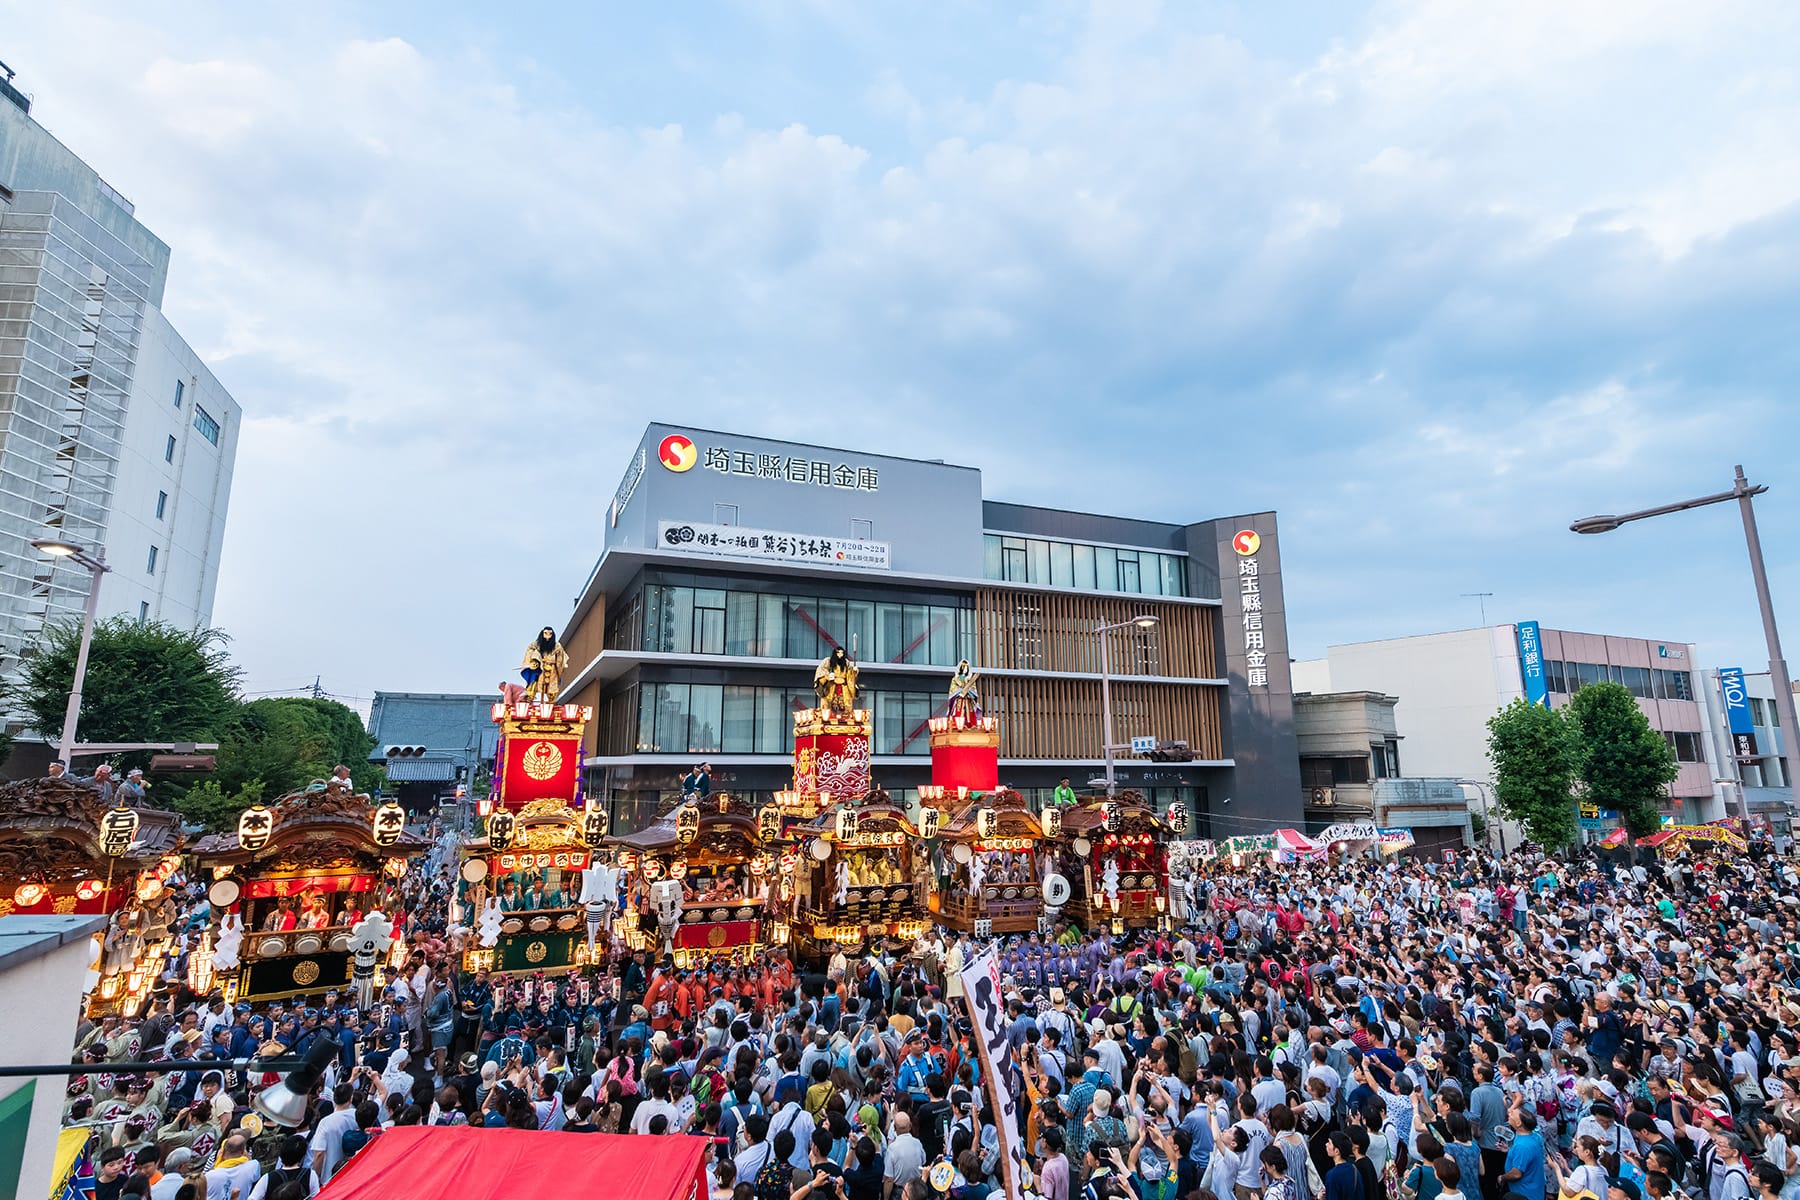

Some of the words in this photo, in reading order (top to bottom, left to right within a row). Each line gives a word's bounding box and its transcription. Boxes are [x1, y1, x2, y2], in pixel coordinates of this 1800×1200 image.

[704, 447, 878, 491] 埼玉縣信用金庫
[1239, 558, 1268, 687] 埼玉縣信用金庫
[1521, 626, 1540, 678] 足利銀行
[1722, 670, 1744, 710] TOWA
[242, 814, 270, 849] 本石
[376, 811, 402, 845] 本石
[489, 815, 514, 849] 仲町
[584, 813, 607, 847] 仲町
